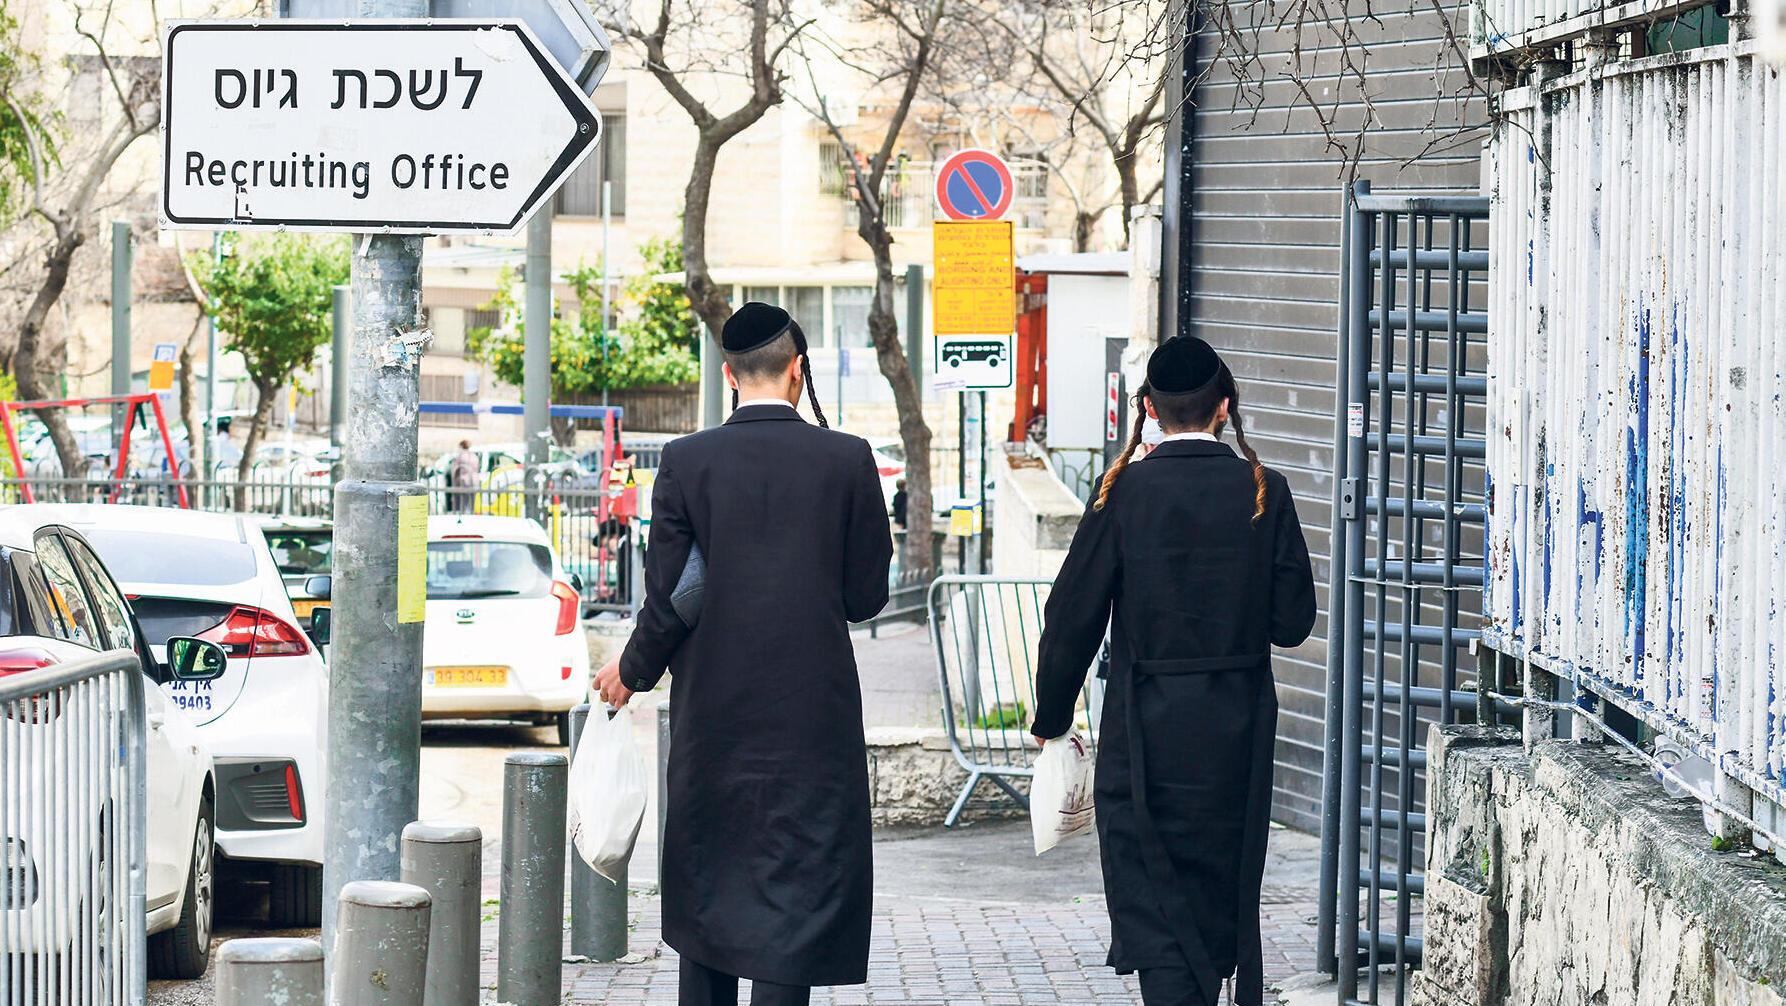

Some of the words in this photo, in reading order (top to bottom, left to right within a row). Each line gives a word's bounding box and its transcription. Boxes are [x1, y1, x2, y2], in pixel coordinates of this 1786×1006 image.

[215, 69, 298, 109] גיוס
[330, 57, 483, 111] לשכת
[185, 151, 370, 199] Recruiting
[391, 153, 509, 190] Office
